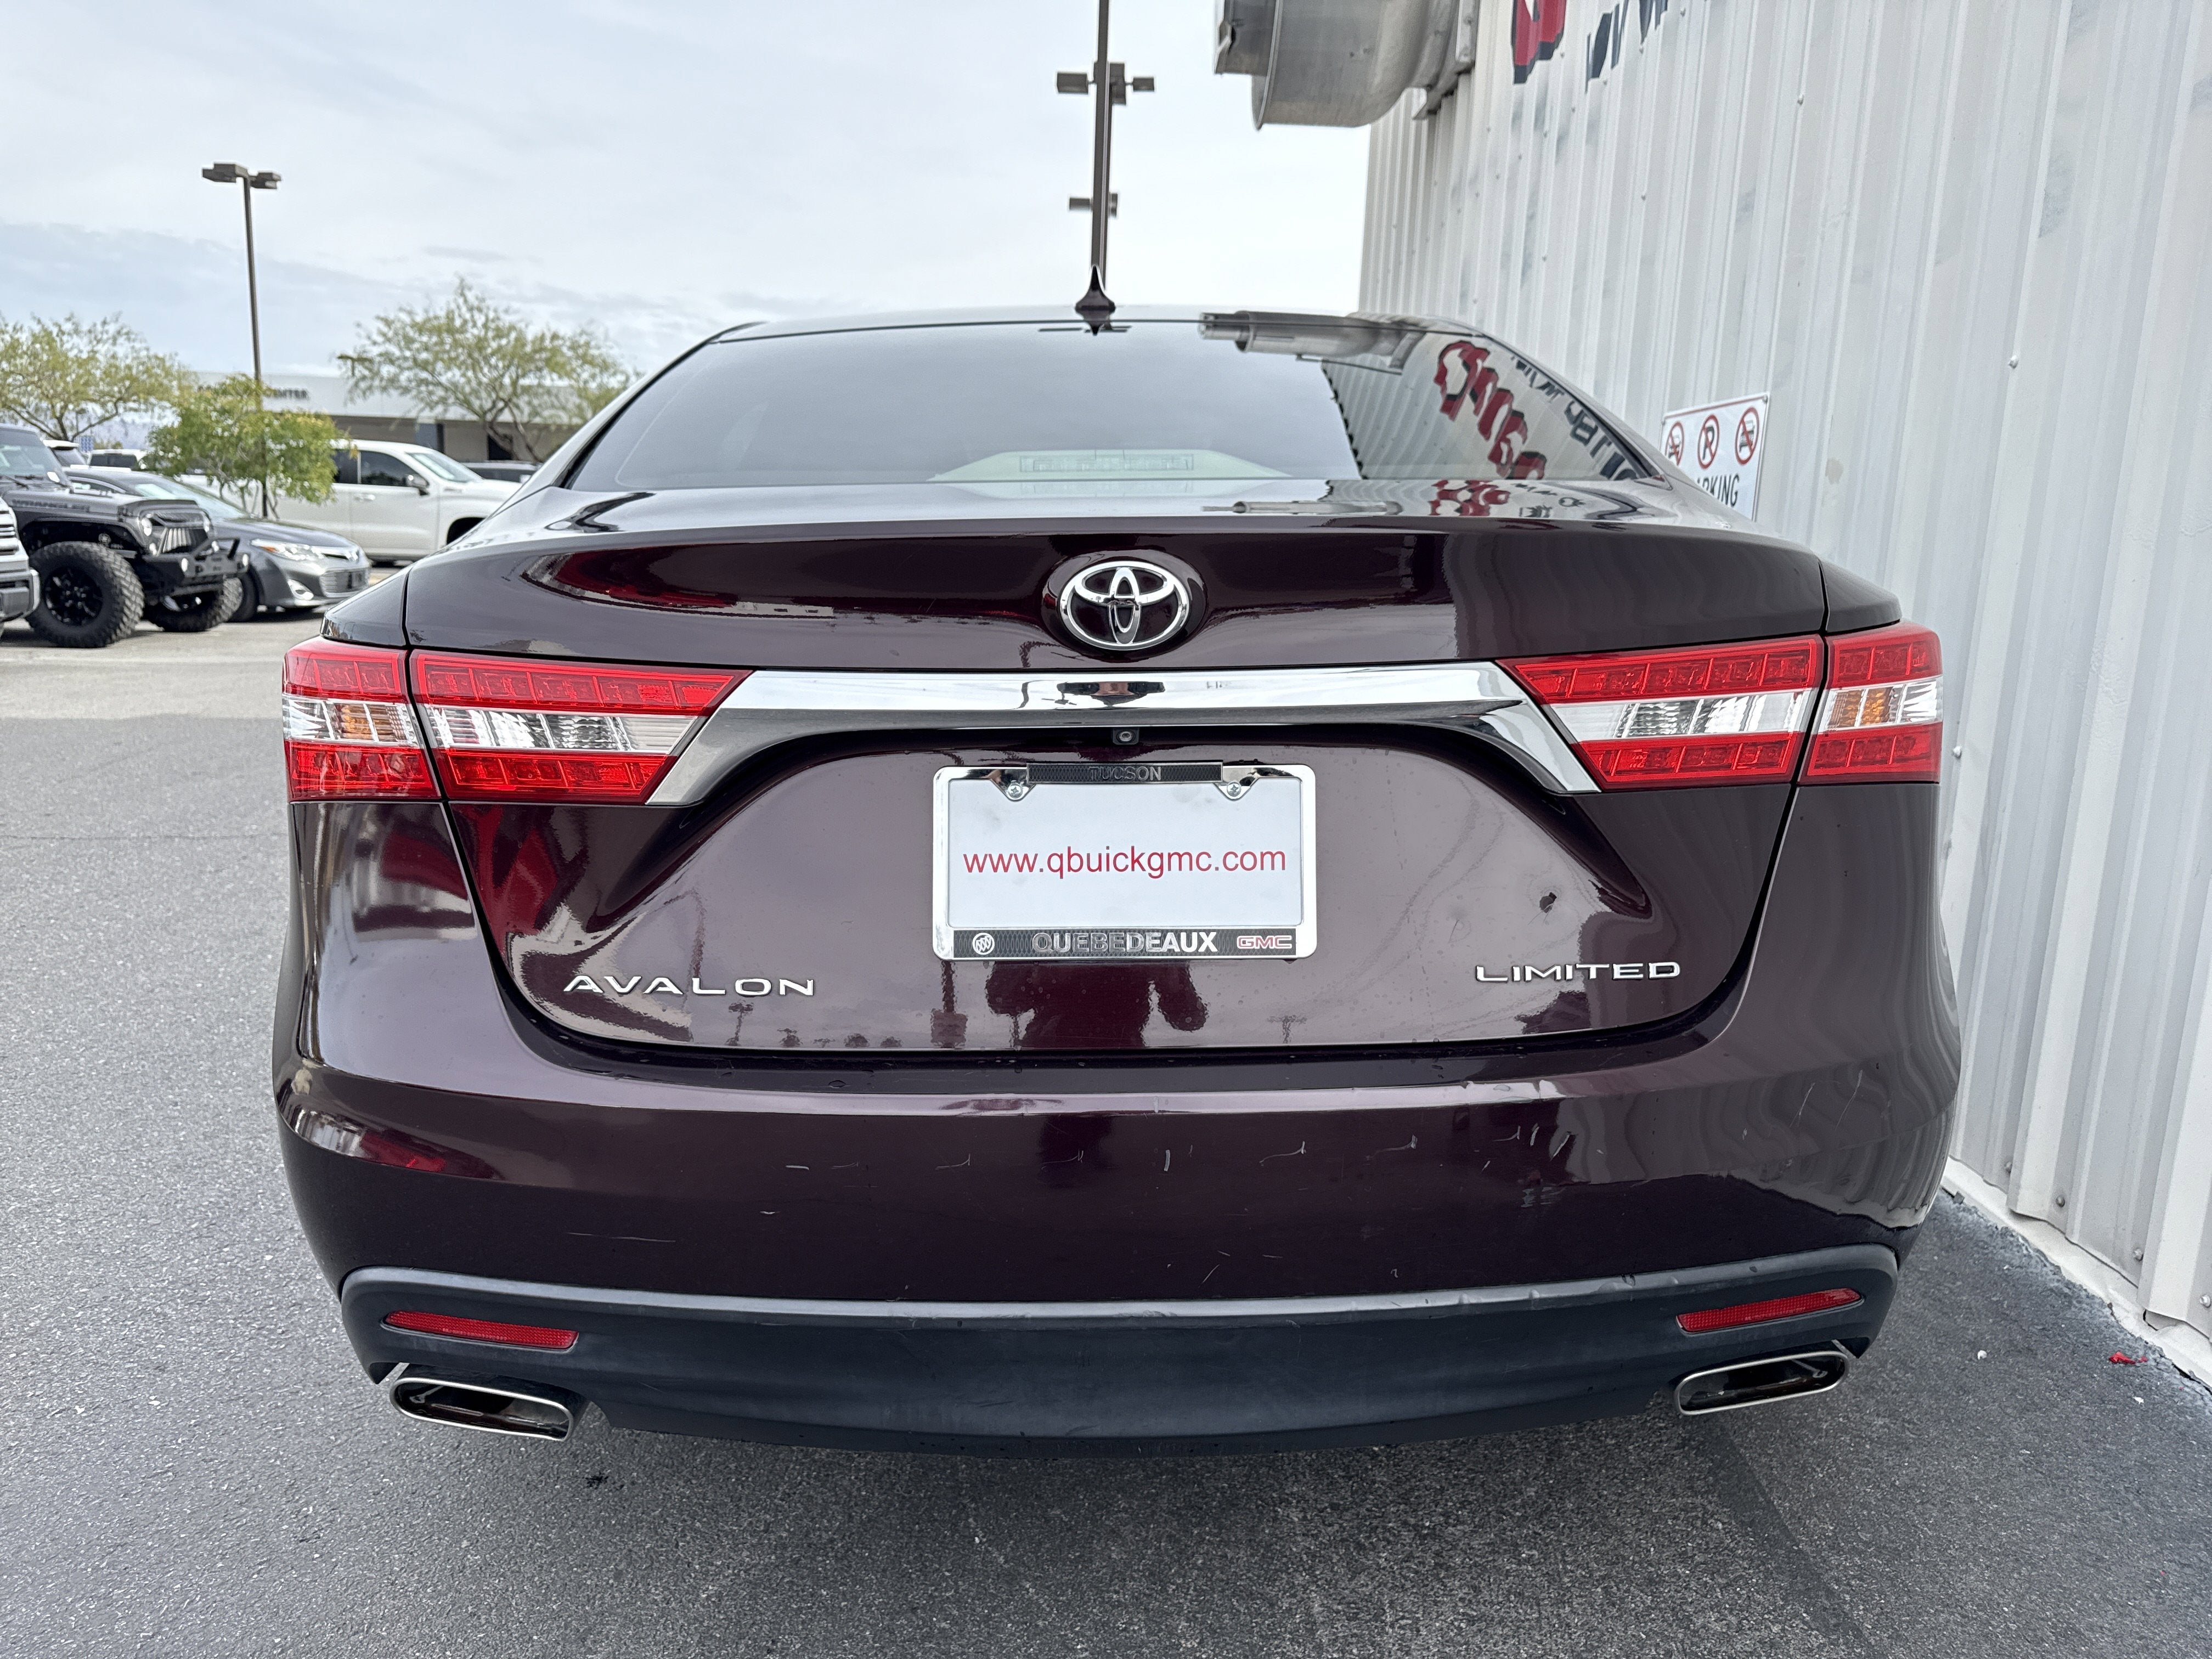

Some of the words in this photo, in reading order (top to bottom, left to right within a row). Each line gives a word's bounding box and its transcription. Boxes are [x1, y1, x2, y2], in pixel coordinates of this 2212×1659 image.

[1088, 766, 1161, 782] TUCSON
[963, 845, 1286, 879] www.qbuickgmc.com
[1032, 932, 1218, 953] QUEBEDEAUX
[1237, 935, 1293, 950] GMC
[1476, 961, 1681, 983] LIMITED
[563, 975, 815, 997] AVALON
